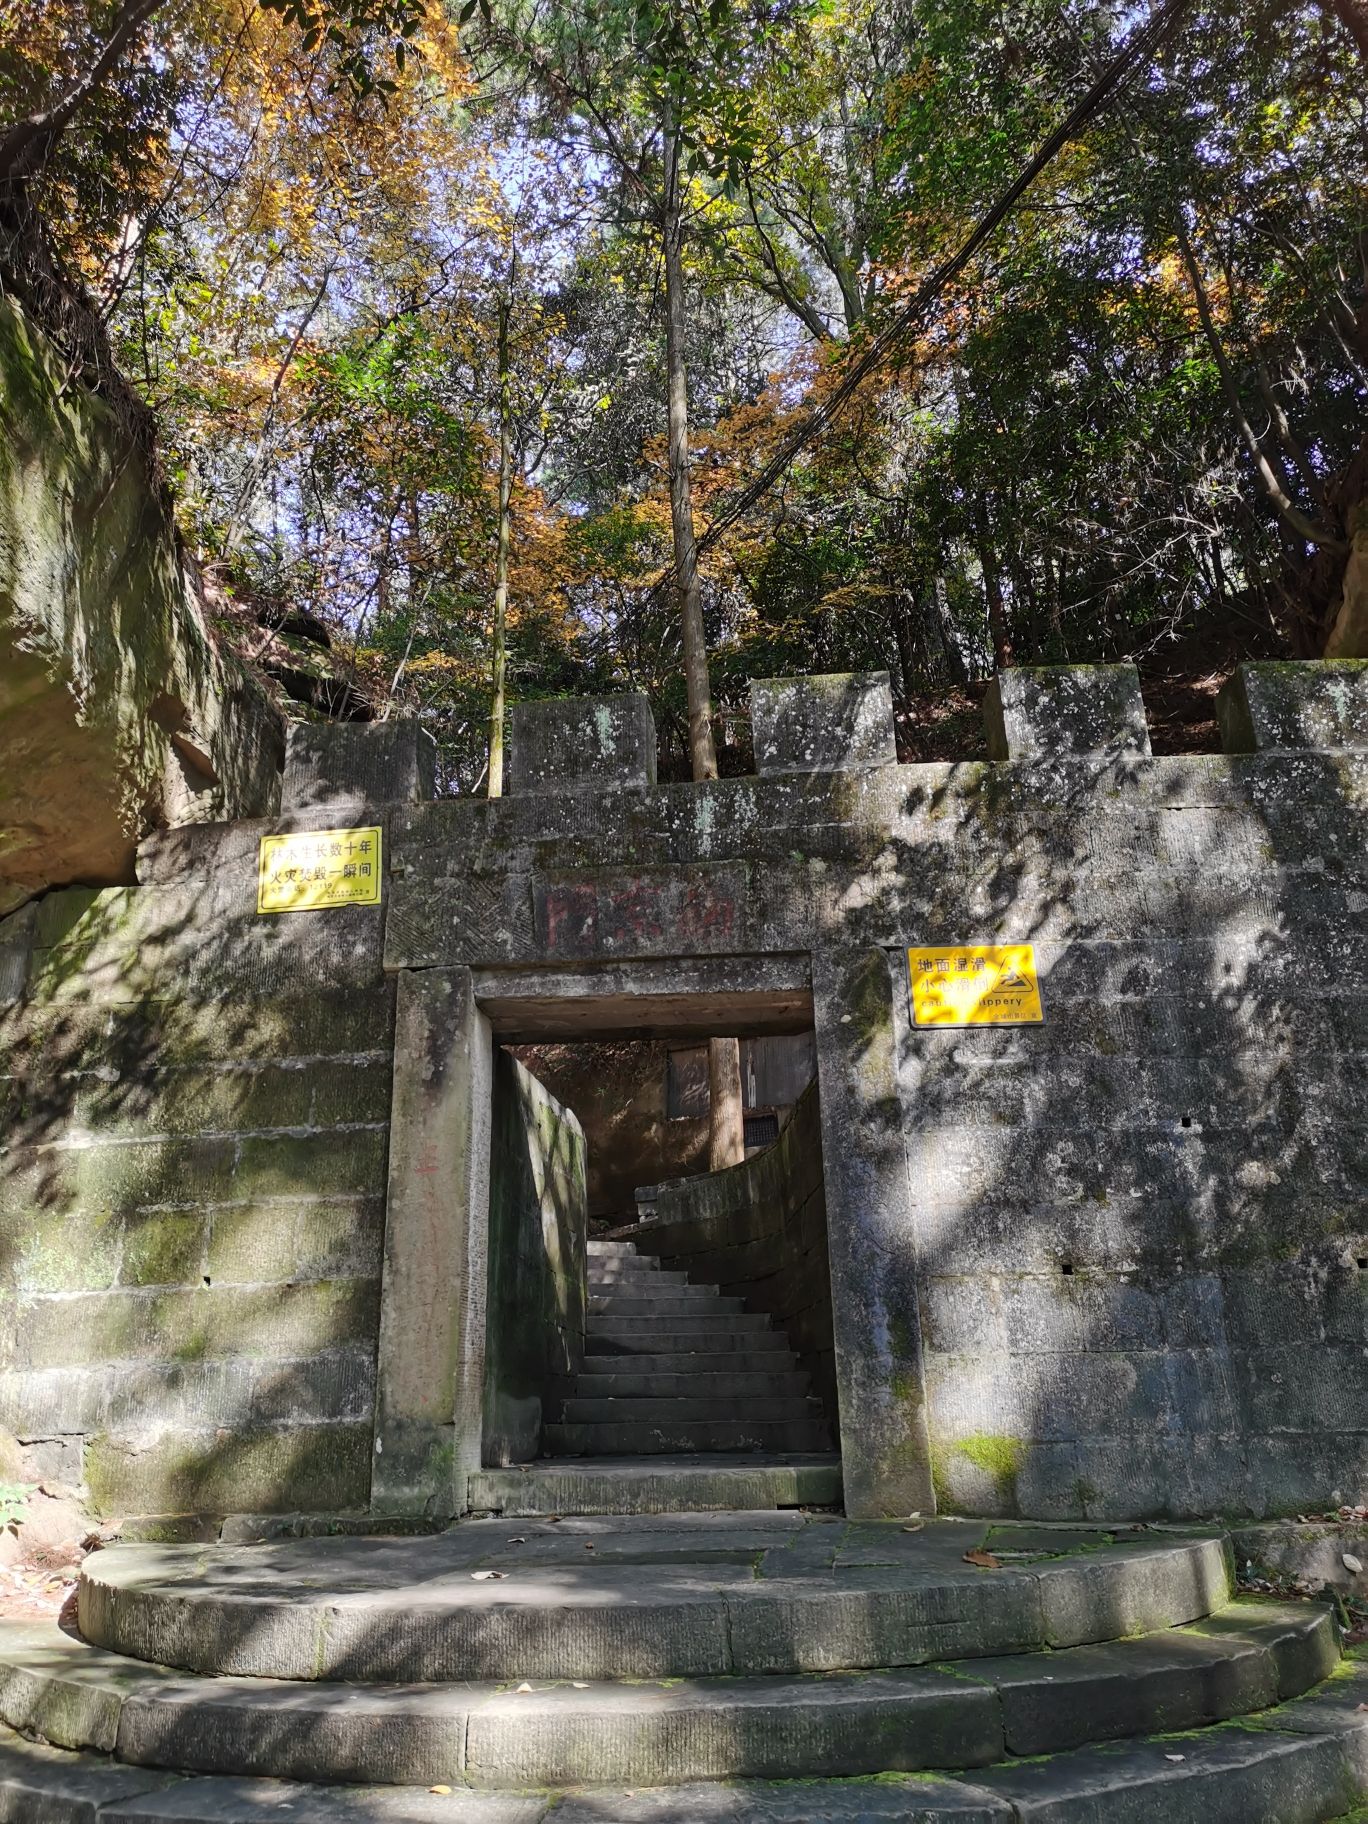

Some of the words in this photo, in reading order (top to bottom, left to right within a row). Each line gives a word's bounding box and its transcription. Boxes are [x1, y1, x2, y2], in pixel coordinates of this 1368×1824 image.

[918, 957, 986, 972] 地面湿滑
[921, 976, 989, 993] 小心滑倒
